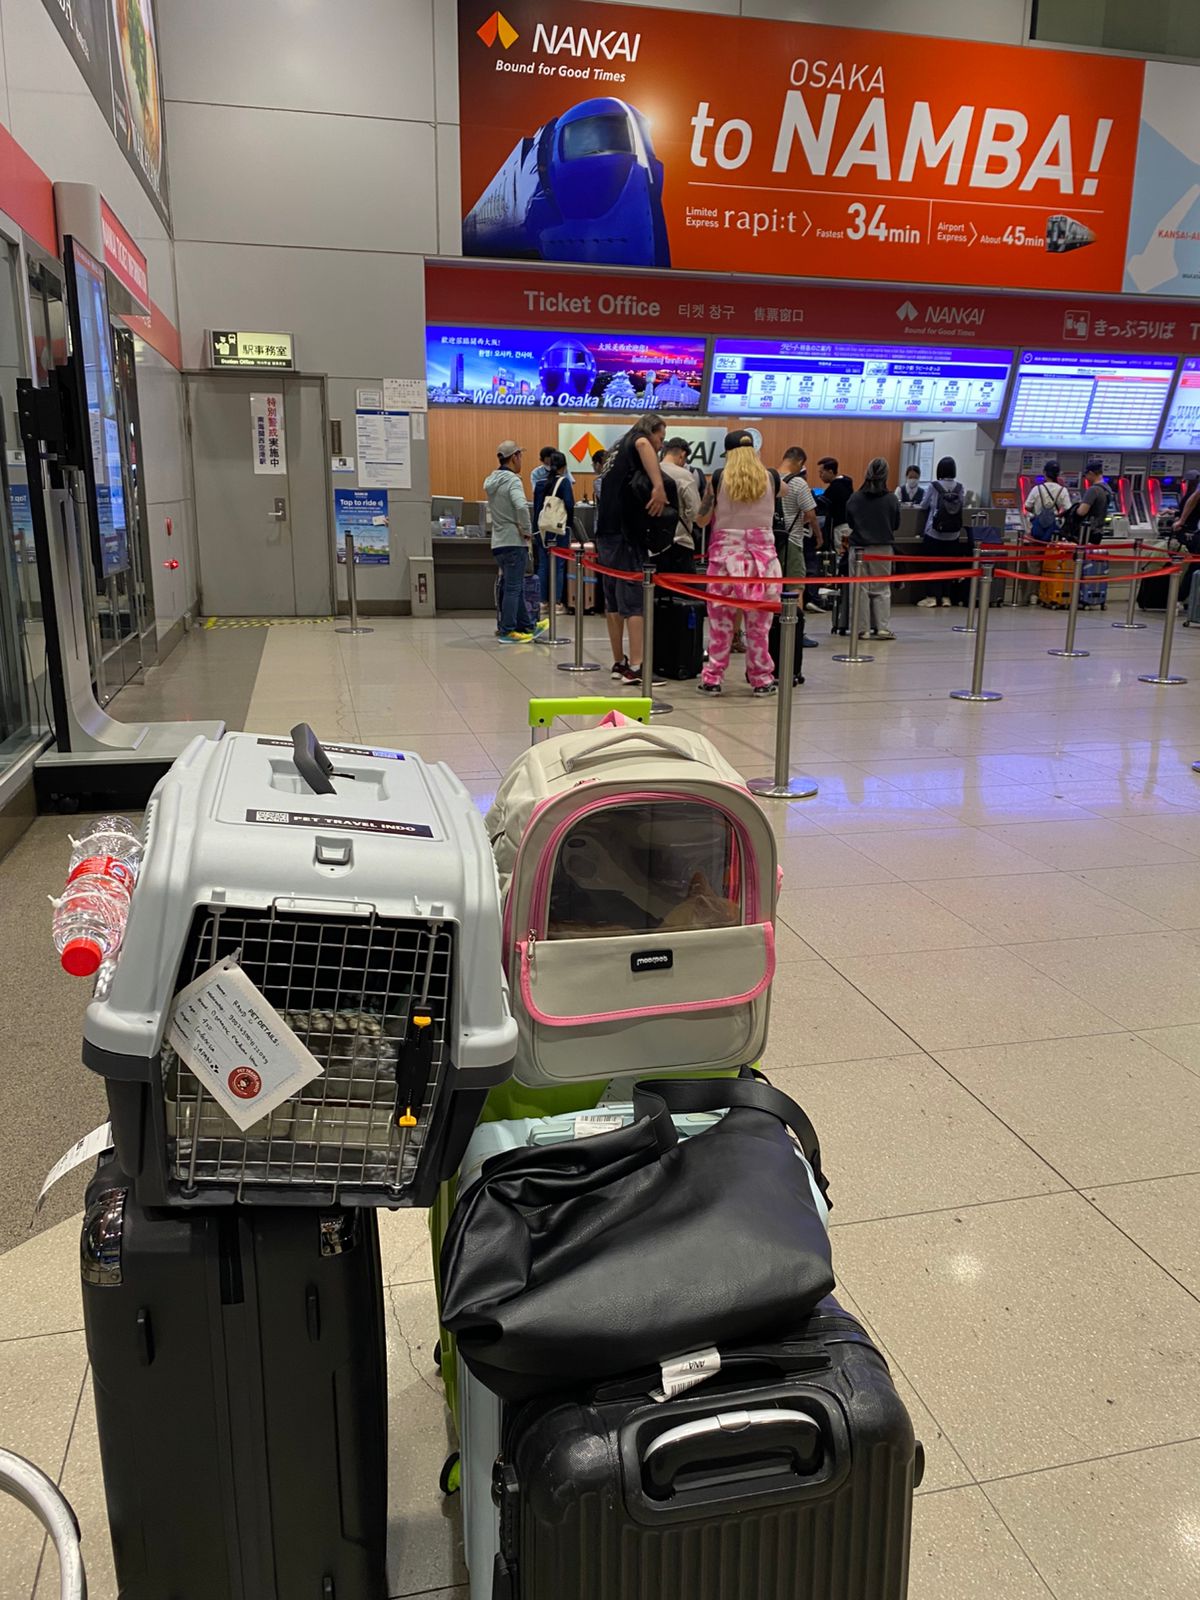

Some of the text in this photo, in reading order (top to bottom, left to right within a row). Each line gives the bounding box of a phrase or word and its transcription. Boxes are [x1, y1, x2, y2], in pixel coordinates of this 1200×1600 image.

[532, 23, 641, 62] NANKAI
[495, 59, 626, 83] Bound for Good Times
[789, 58, 886, 94] OSAKA
[689, 89, 1114, 197] to NAMBA!
[686, 206, 718, 217] Limited
[685, 216, 720, 229] Express
[937, 222, 965, 233] Airport
[816, 228, 844, 239] Fastest
[936, 231, 968, 243] Express
[980, 235, 1001, 245] About
[523, 289, 662, 318] Ticket Office
[678, 303, 736, 321] 티켓 창구
[924, 305, 985, 326] NANKAI
[904, 326, 976, 337] Bound for Good Times
[1093, 318, 1176, 341] きっぷうりば
[243, 344, 287, 356] 駅事務室
[473, 389, 536, 405] Welcome
[540, 392, 554, 407] to
[557, 392, 600, 408] Osaka
[602, 393, 659, 410] Kansai!!
[340, 498, 353, 506] Tap
[293, 815, 319, 823] PET
[324, 817, 378, 829] TRAVEL
[382, 824, 416, 832] INDO
[247, 1008, 259, 1022] PET
